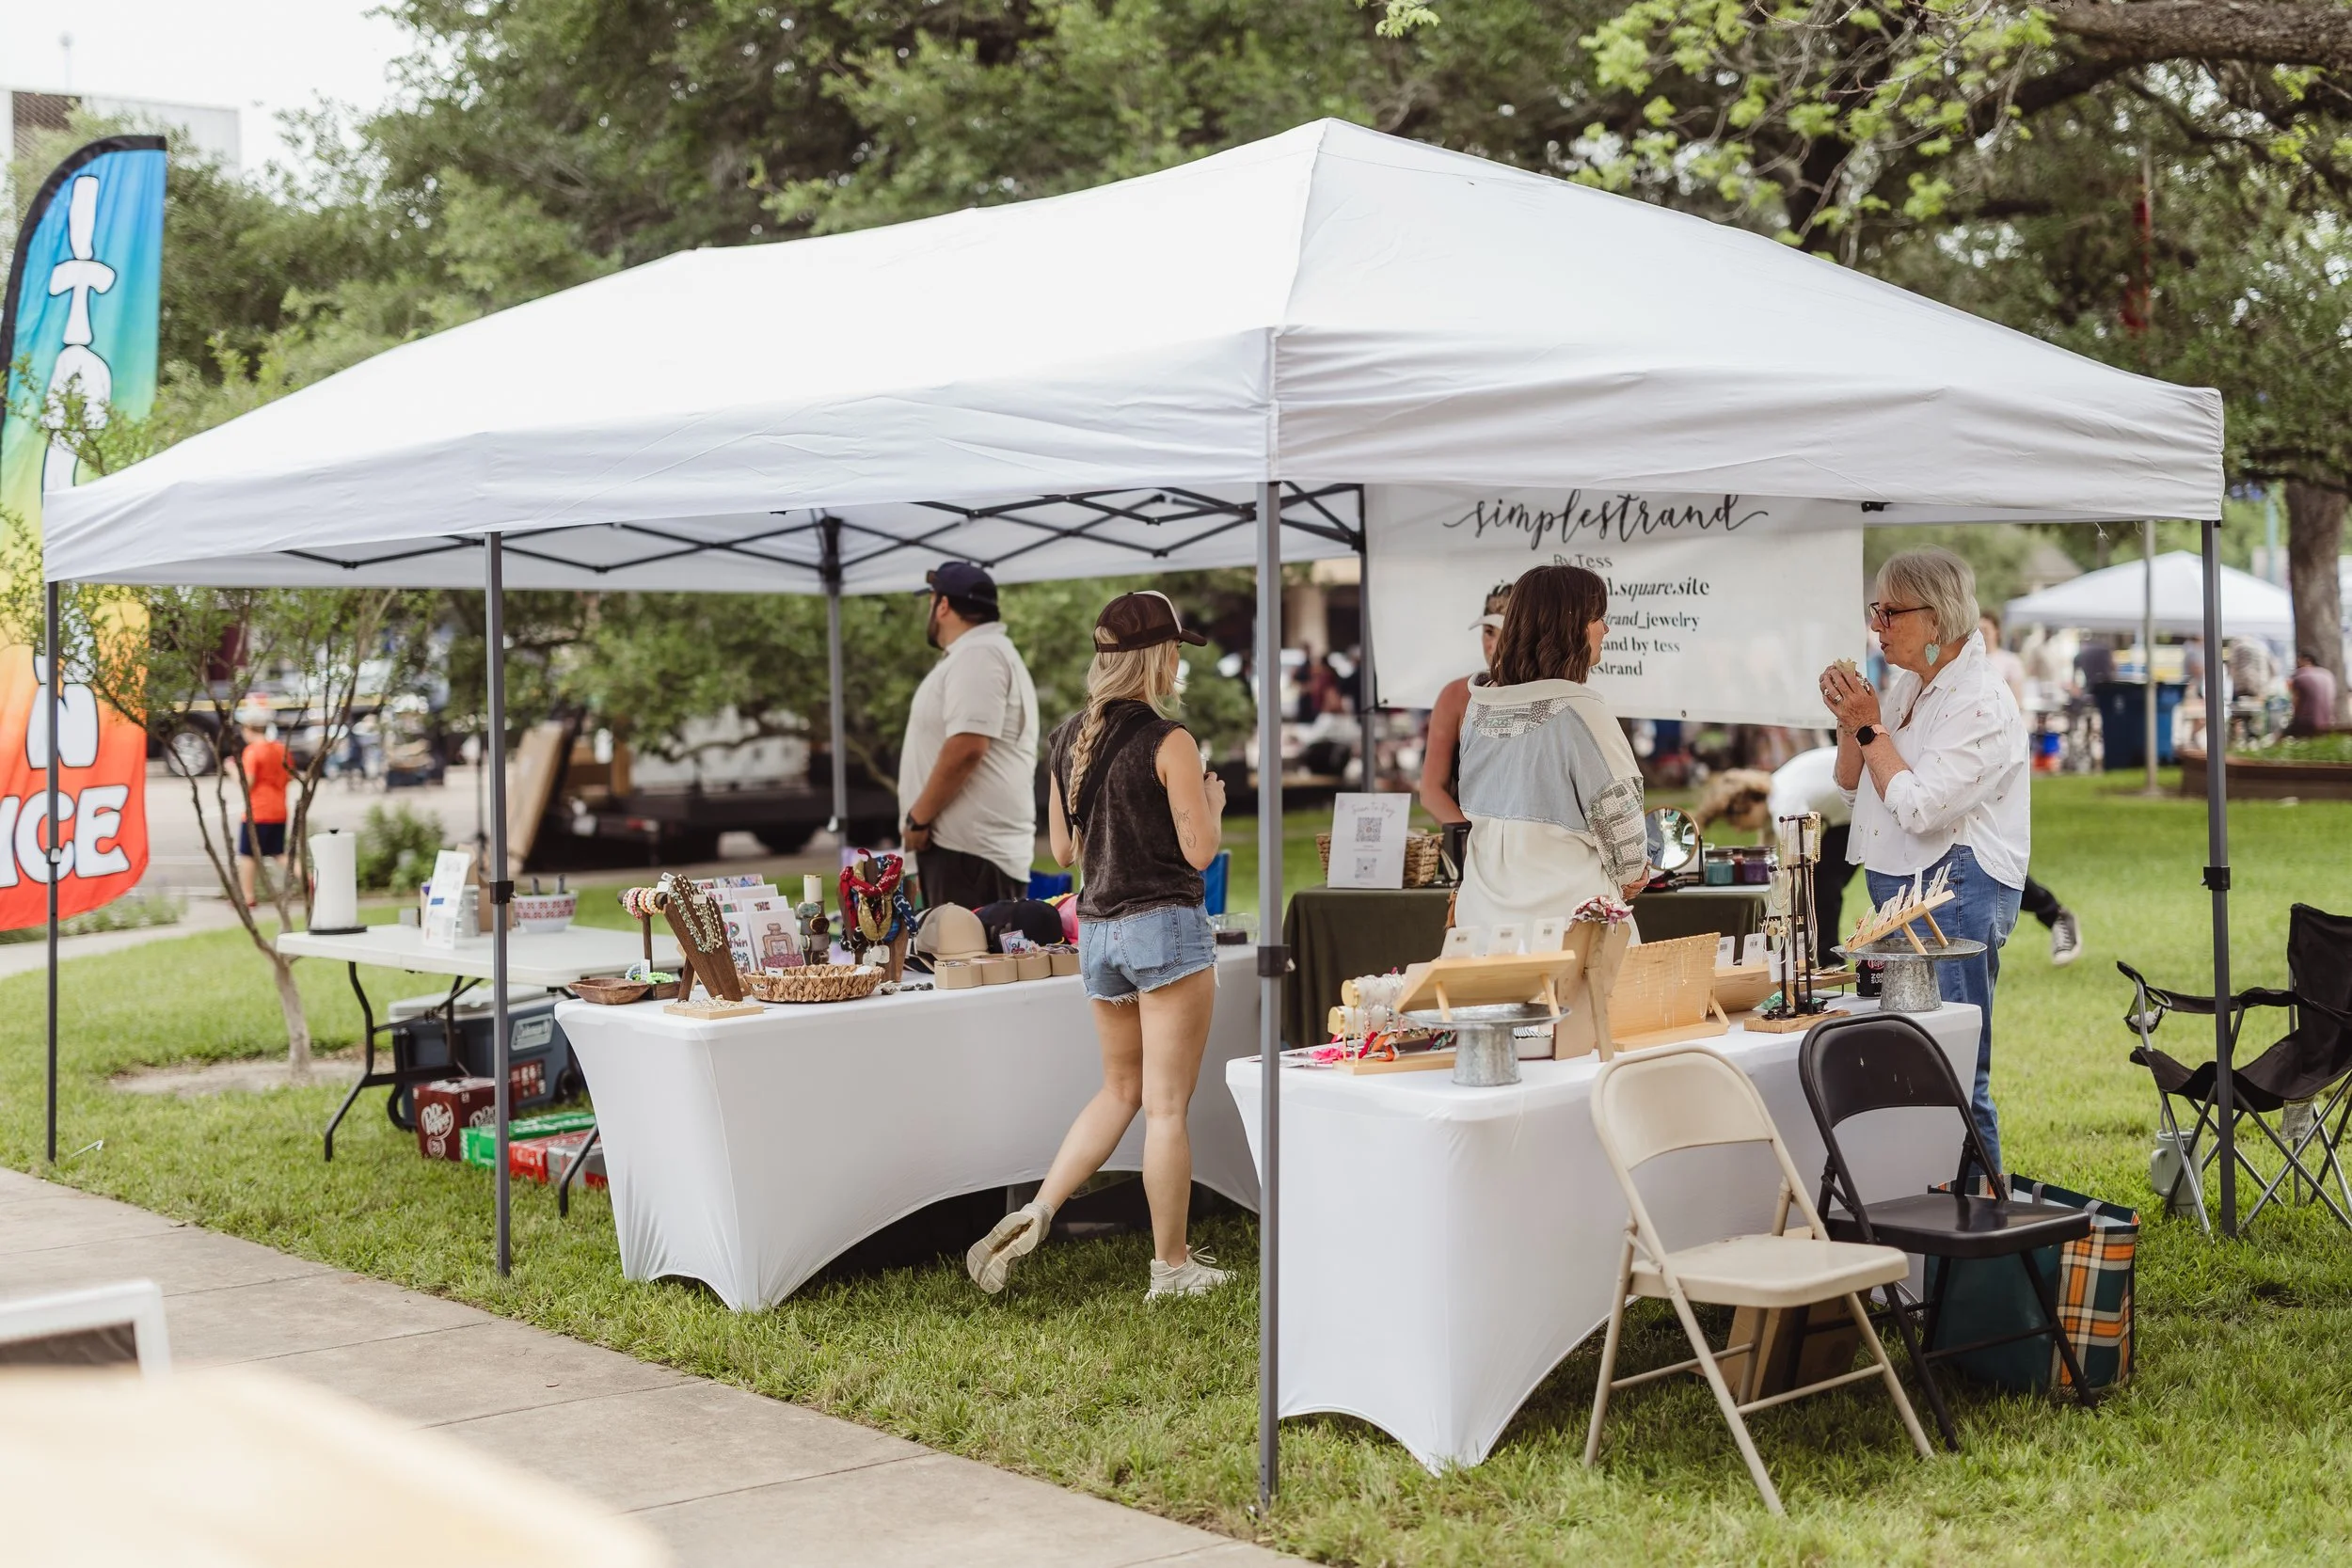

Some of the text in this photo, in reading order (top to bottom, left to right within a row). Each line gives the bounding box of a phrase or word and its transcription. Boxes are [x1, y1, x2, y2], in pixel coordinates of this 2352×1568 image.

[1442, 488, 1770, 550] simplestrand
[1574, 553, 1613, 569] Tess
[1607, 576, 1710, 602] .square.site
[1605, 610, 1700, 632] trand_jewelry
[1602, 636, 1681, 657] and by tess
[1590, 660, 1644, 676] estrand
